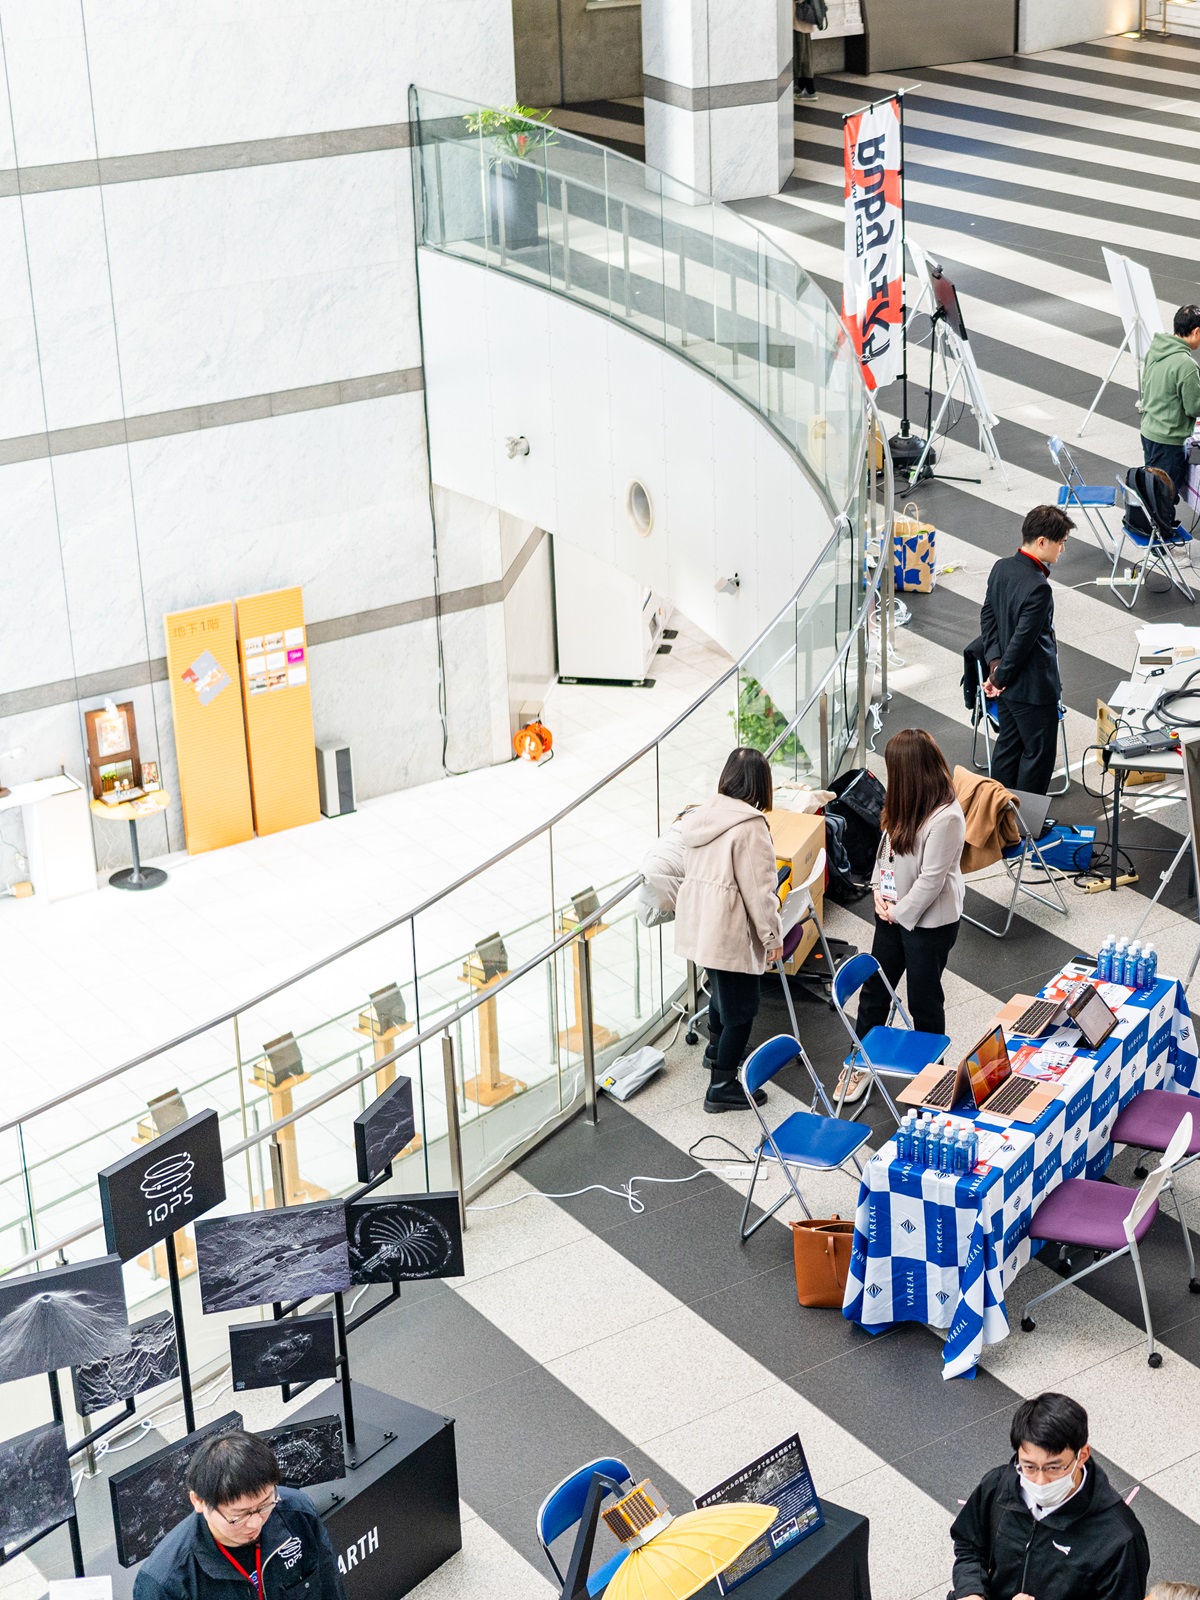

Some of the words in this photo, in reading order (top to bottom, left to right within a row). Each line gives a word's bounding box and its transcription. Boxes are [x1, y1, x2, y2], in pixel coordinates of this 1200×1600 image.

[1070, 1093, 1089, 1115] VAREAL
[1009, 1160, 1028, 1184] VAREAL
[968, 1175, 986, 1198] VAREA
[147, 1186, 194, 1227] iQPS
[869, 1204, 877, 1244] VAREAL
[906, 1270, 914, 1306] VAREAL
[946, 1318, 969, 1344] VAREAL
